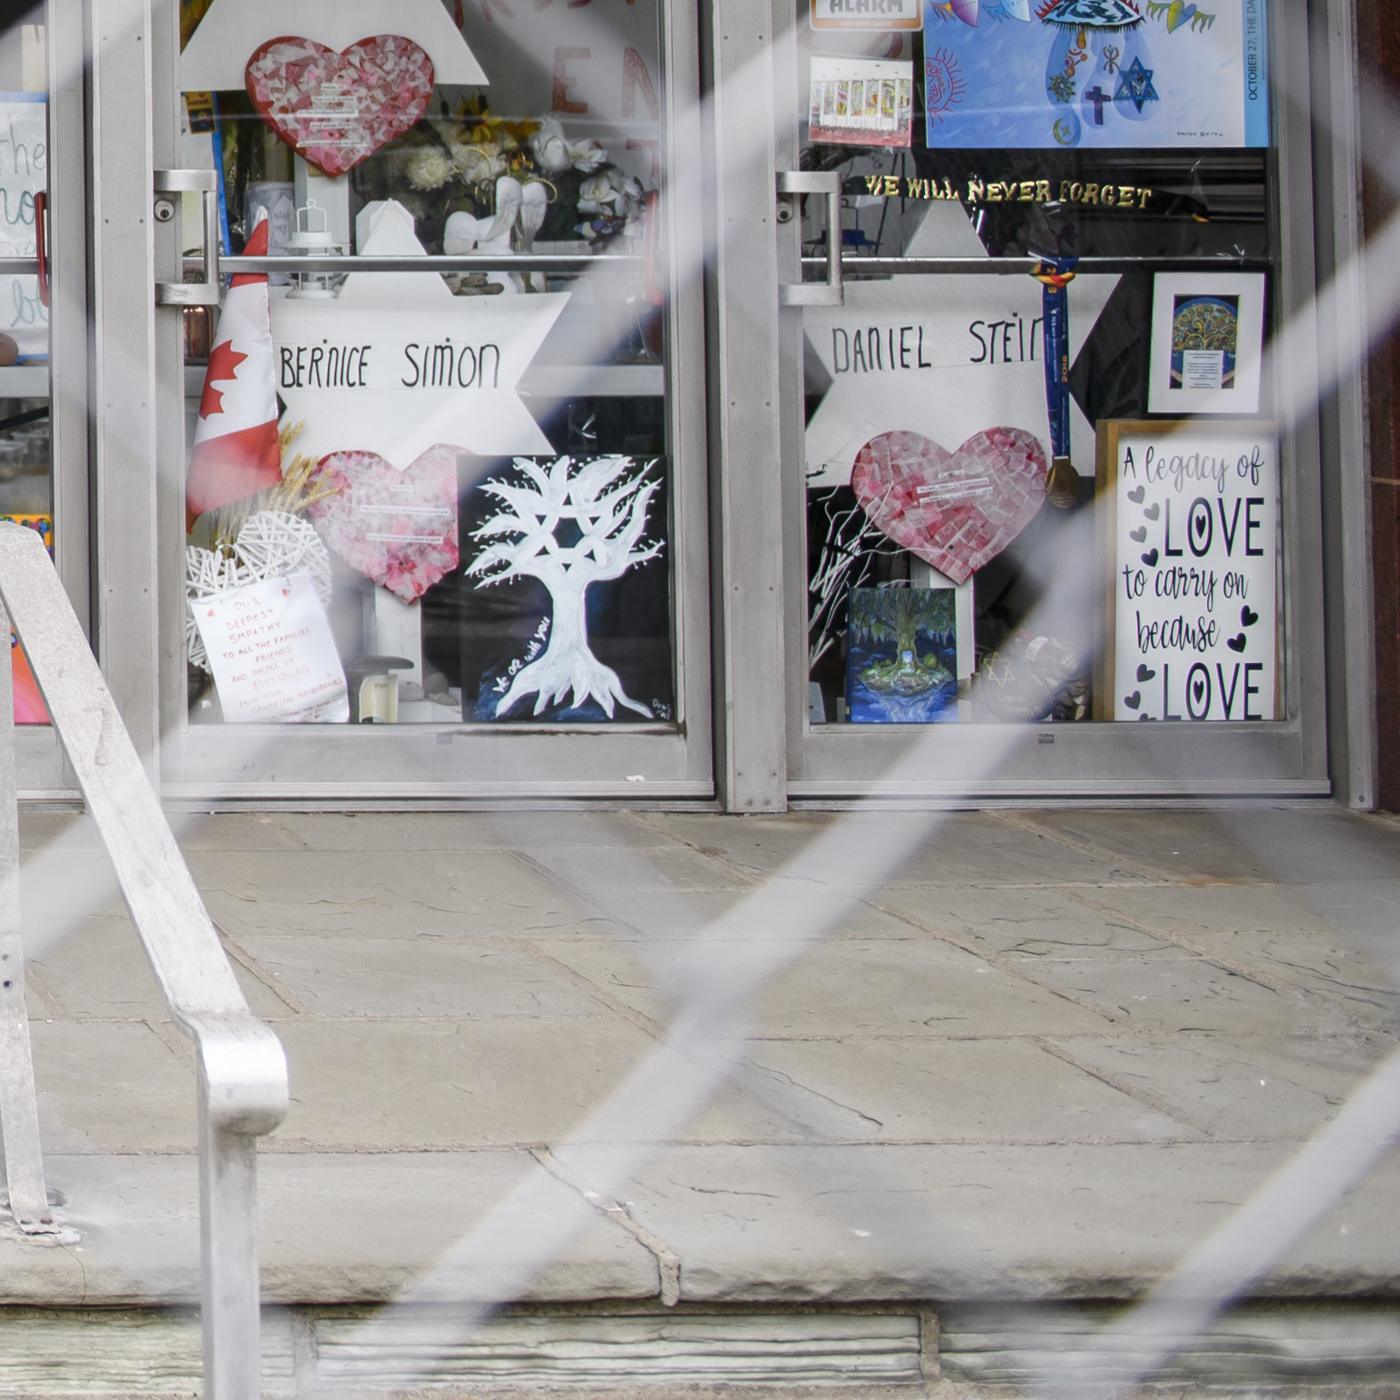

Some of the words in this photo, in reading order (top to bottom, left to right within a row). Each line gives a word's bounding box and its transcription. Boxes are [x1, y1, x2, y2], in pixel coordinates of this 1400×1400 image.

[1246, 17, 1256, 34] THE
[1247, 54, 1257, 100] OCTOBER
[864, 176, 900, 197] WE
[907, 177, 958, 200] WILL
[968, 180, 1052, 203] NEVER
[1059, 181, 1151, 210] FORGET
[280, 344, 371, 387] BERNICE
[401, 342, 500, 388] SIMON
[832, 325, 932, 374] DANIEL
[1122, 447, 1137, 477] A
[1145, 450, 1230, 492] legacy
[1236, 445, 1264, 484] of
[1164, 497, 1264, 558] LOVE
[1122, 563, 1148, 599] to
[1154, 570, 1218, 613] carry
[1223, 569, 1248, 600] on
[1136, 610, 1220, 653] because
[1163, 662, 1263, 721] LOVE
